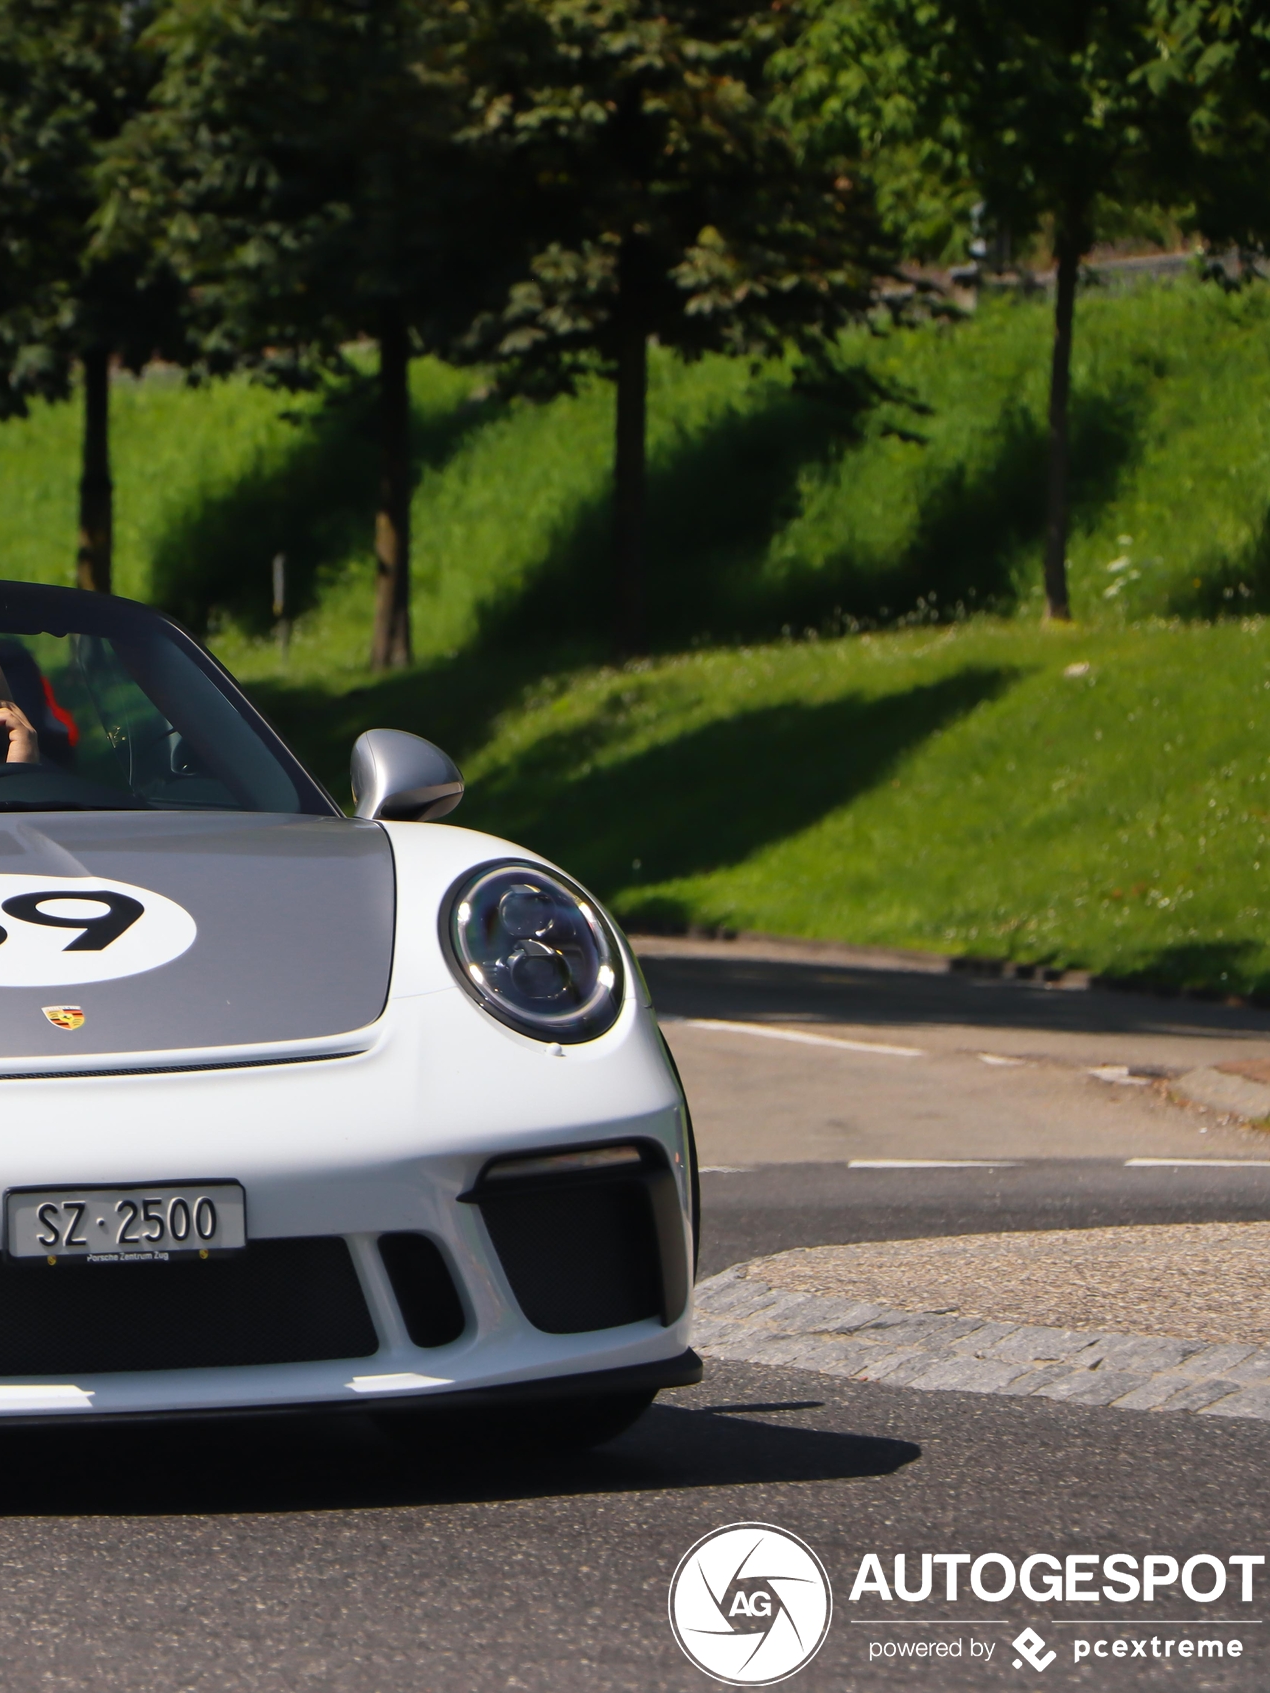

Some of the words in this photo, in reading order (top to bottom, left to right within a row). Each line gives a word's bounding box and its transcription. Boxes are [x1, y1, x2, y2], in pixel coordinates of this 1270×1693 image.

[87, 1253, 118, 1262] Porsche
[119, 1251, 152, 1261] Zentrum
[154, 1250, 169, 1261] Zug
